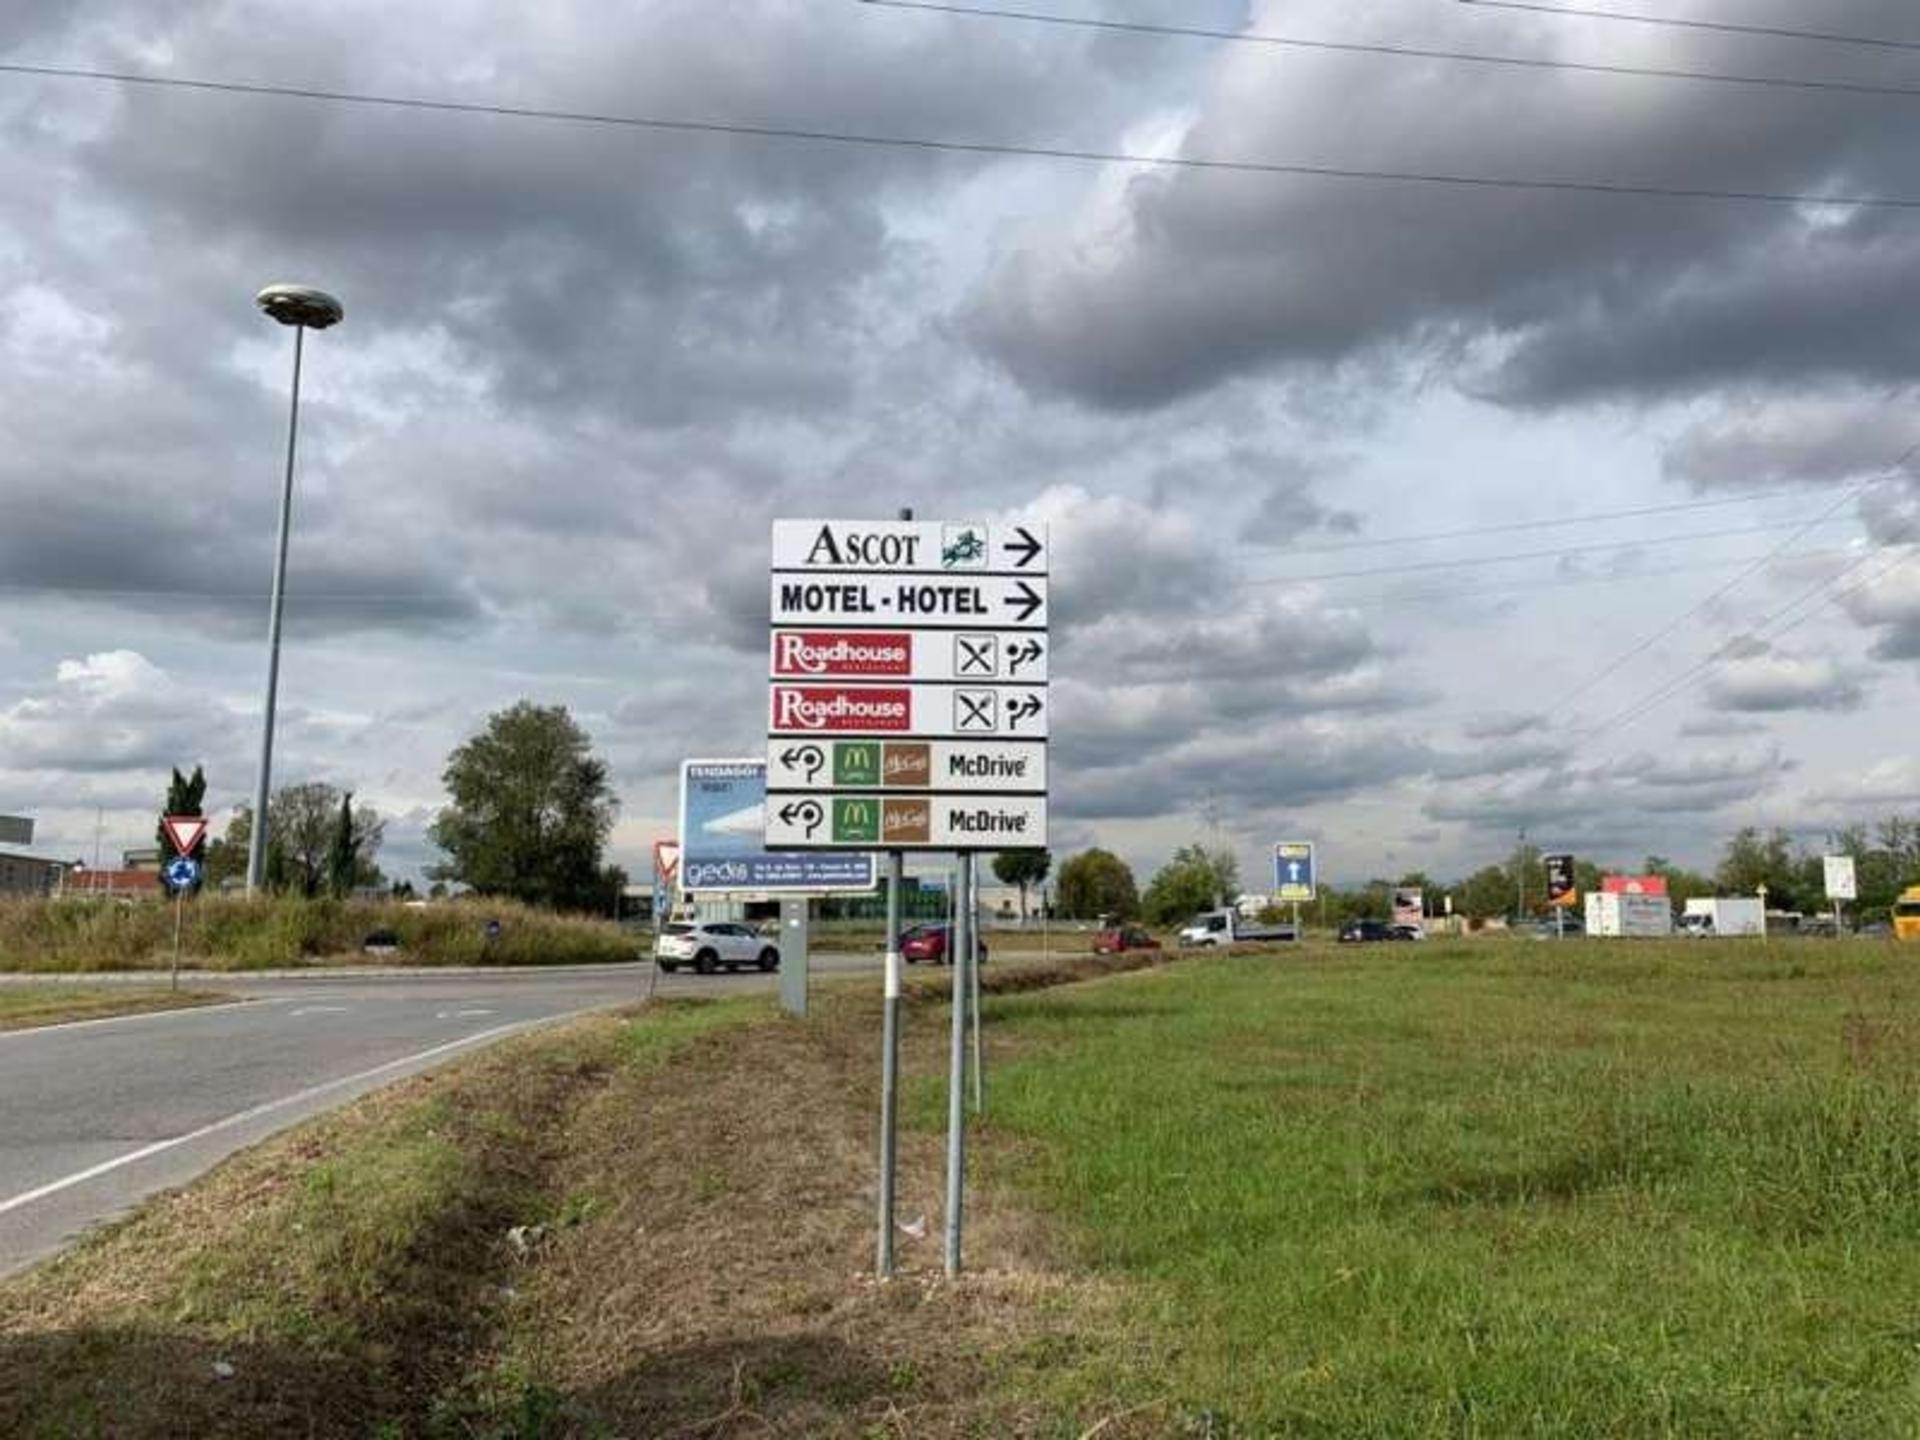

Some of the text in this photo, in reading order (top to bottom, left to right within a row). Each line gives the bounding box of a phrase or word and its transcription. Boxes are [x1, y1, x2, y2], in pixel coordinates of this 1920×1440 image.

[805, 524, 920, 565] ASCOT
[781, 585, 875, 612] MOTEL
[897, 586, 988, 614] HOTEL
[780, 635, 906, 672] Roadhouse
[779, 690, 906, 727] Roadhouse
[949, 755, 1025, 777] McDrive
[949, 811, 1025, 832] McDrive
